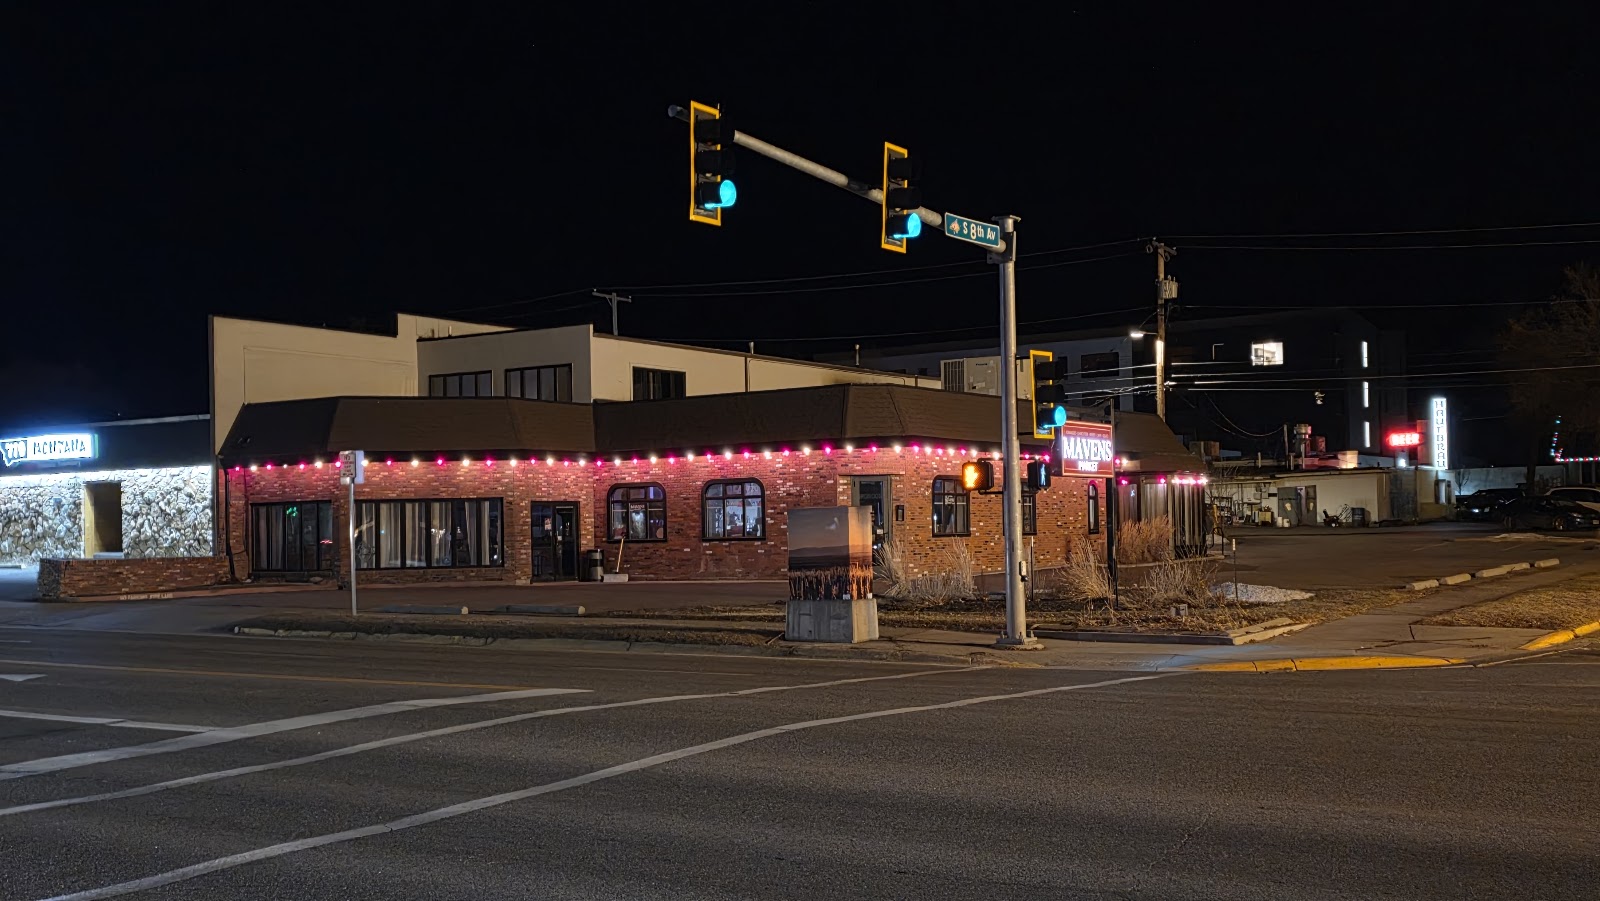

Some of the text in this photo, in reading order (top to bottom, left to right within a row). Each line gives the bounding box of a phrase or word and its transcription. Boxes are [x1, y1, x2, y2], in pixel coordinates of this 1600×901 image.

[962, 221, 996, 241] S 8th Av
[33, 439, 86, 455] MONTANA
[1062, 436, 1113, 461] MAVENS
